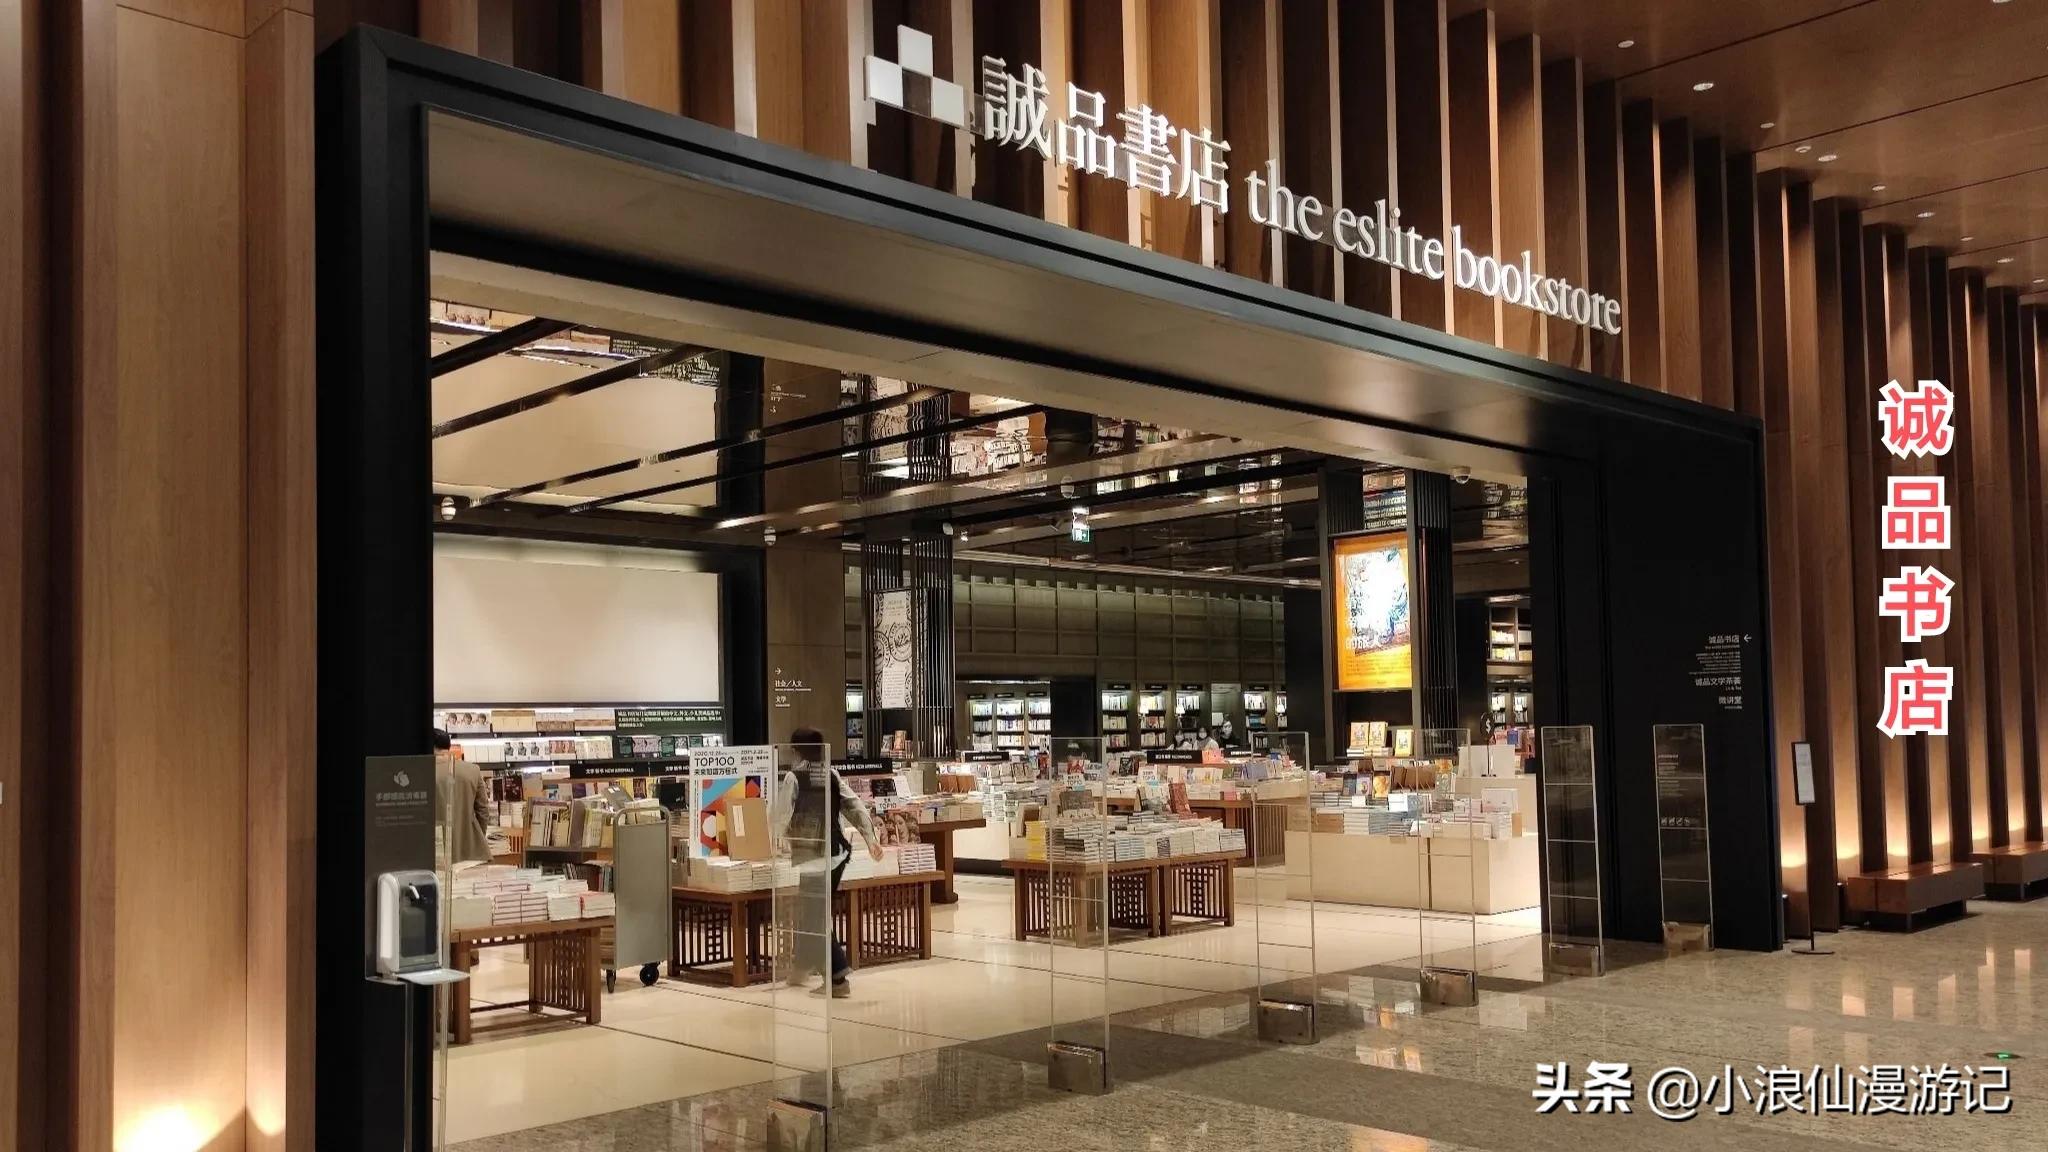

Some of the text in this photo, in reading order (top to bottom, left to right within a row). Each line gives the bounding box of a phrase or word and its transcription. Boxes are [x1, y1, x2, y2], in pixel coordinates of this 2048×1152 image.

[982, 54, 1232, 214] 誠品書店
[1244, 159, 1623, 336] the eslite bookstore
[1709, 635, 1740, 644] 诚品书店
[694, 757, 735, 767] TOP100
